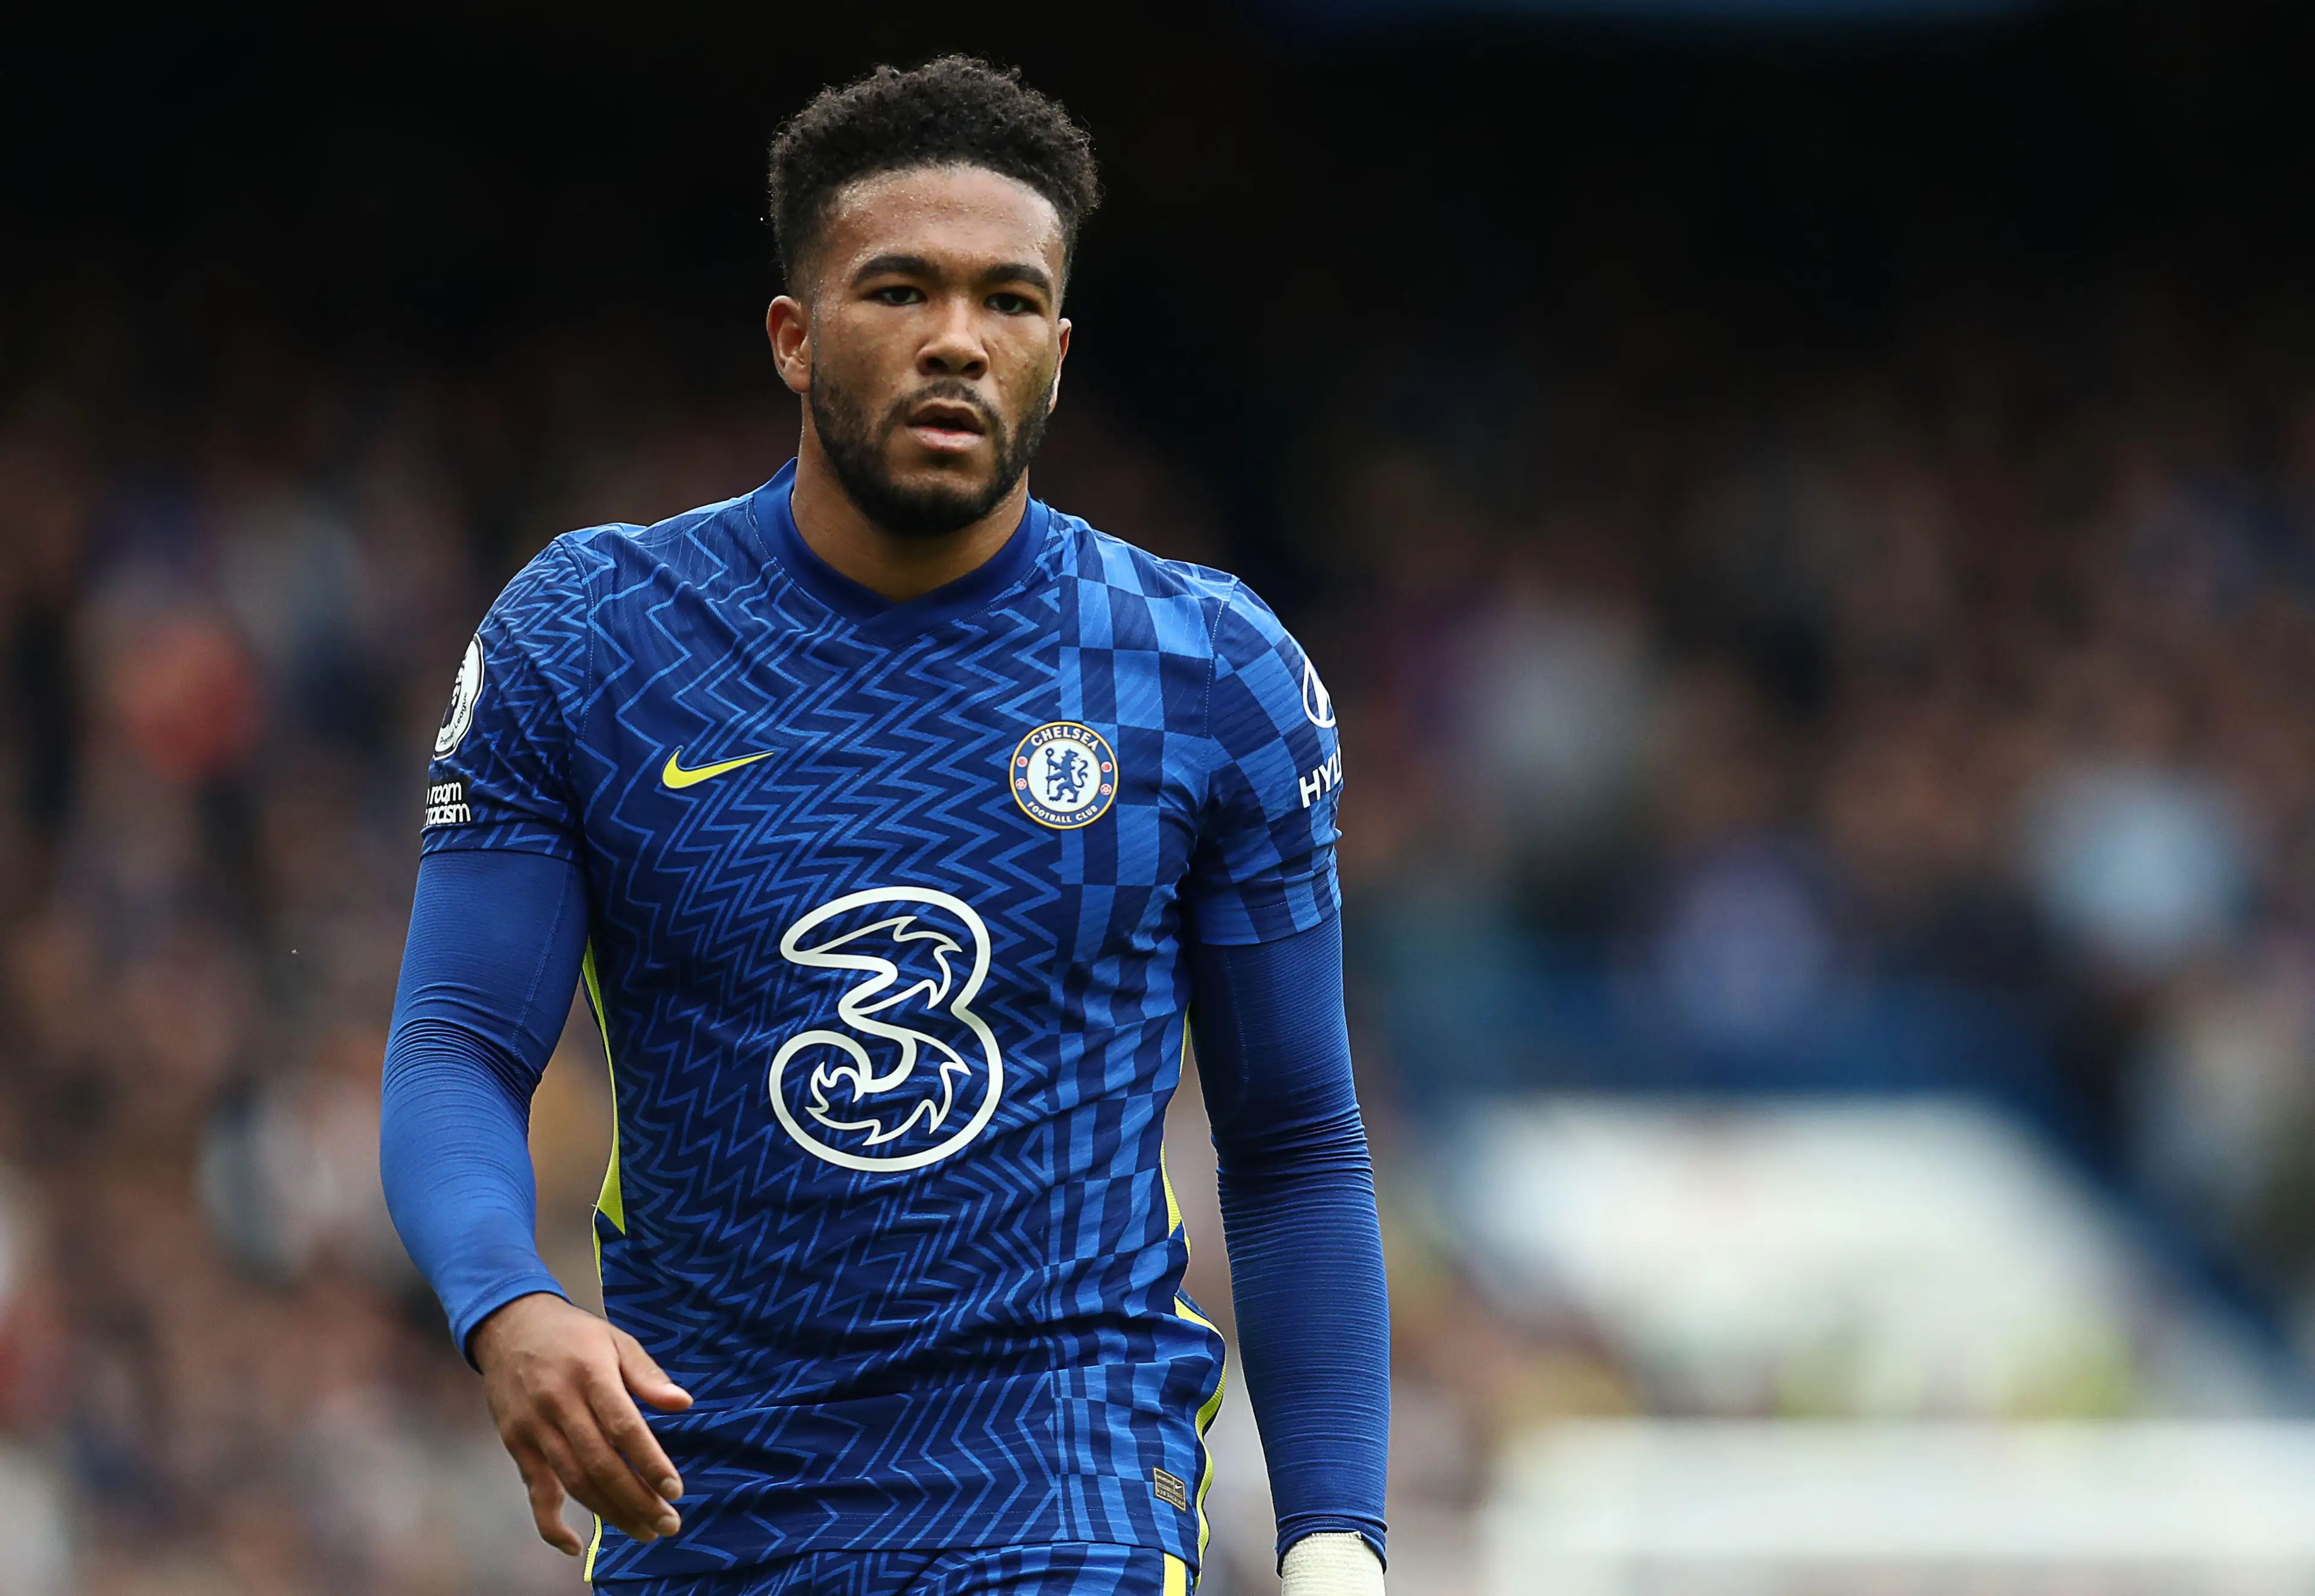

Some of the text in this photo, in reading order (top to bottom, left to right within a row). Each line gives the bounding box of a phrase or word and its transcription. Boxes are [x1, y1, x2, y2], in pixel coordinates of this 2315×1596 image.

[1030, 726, 1100, 752] CHELSEA
[429, 782, 462, 805] room
[426, 803, 471, 826] racism
[1027, 801, 1098, 823] FOOTBALL CLUB
[769, 886, 1003, 1172] 3
